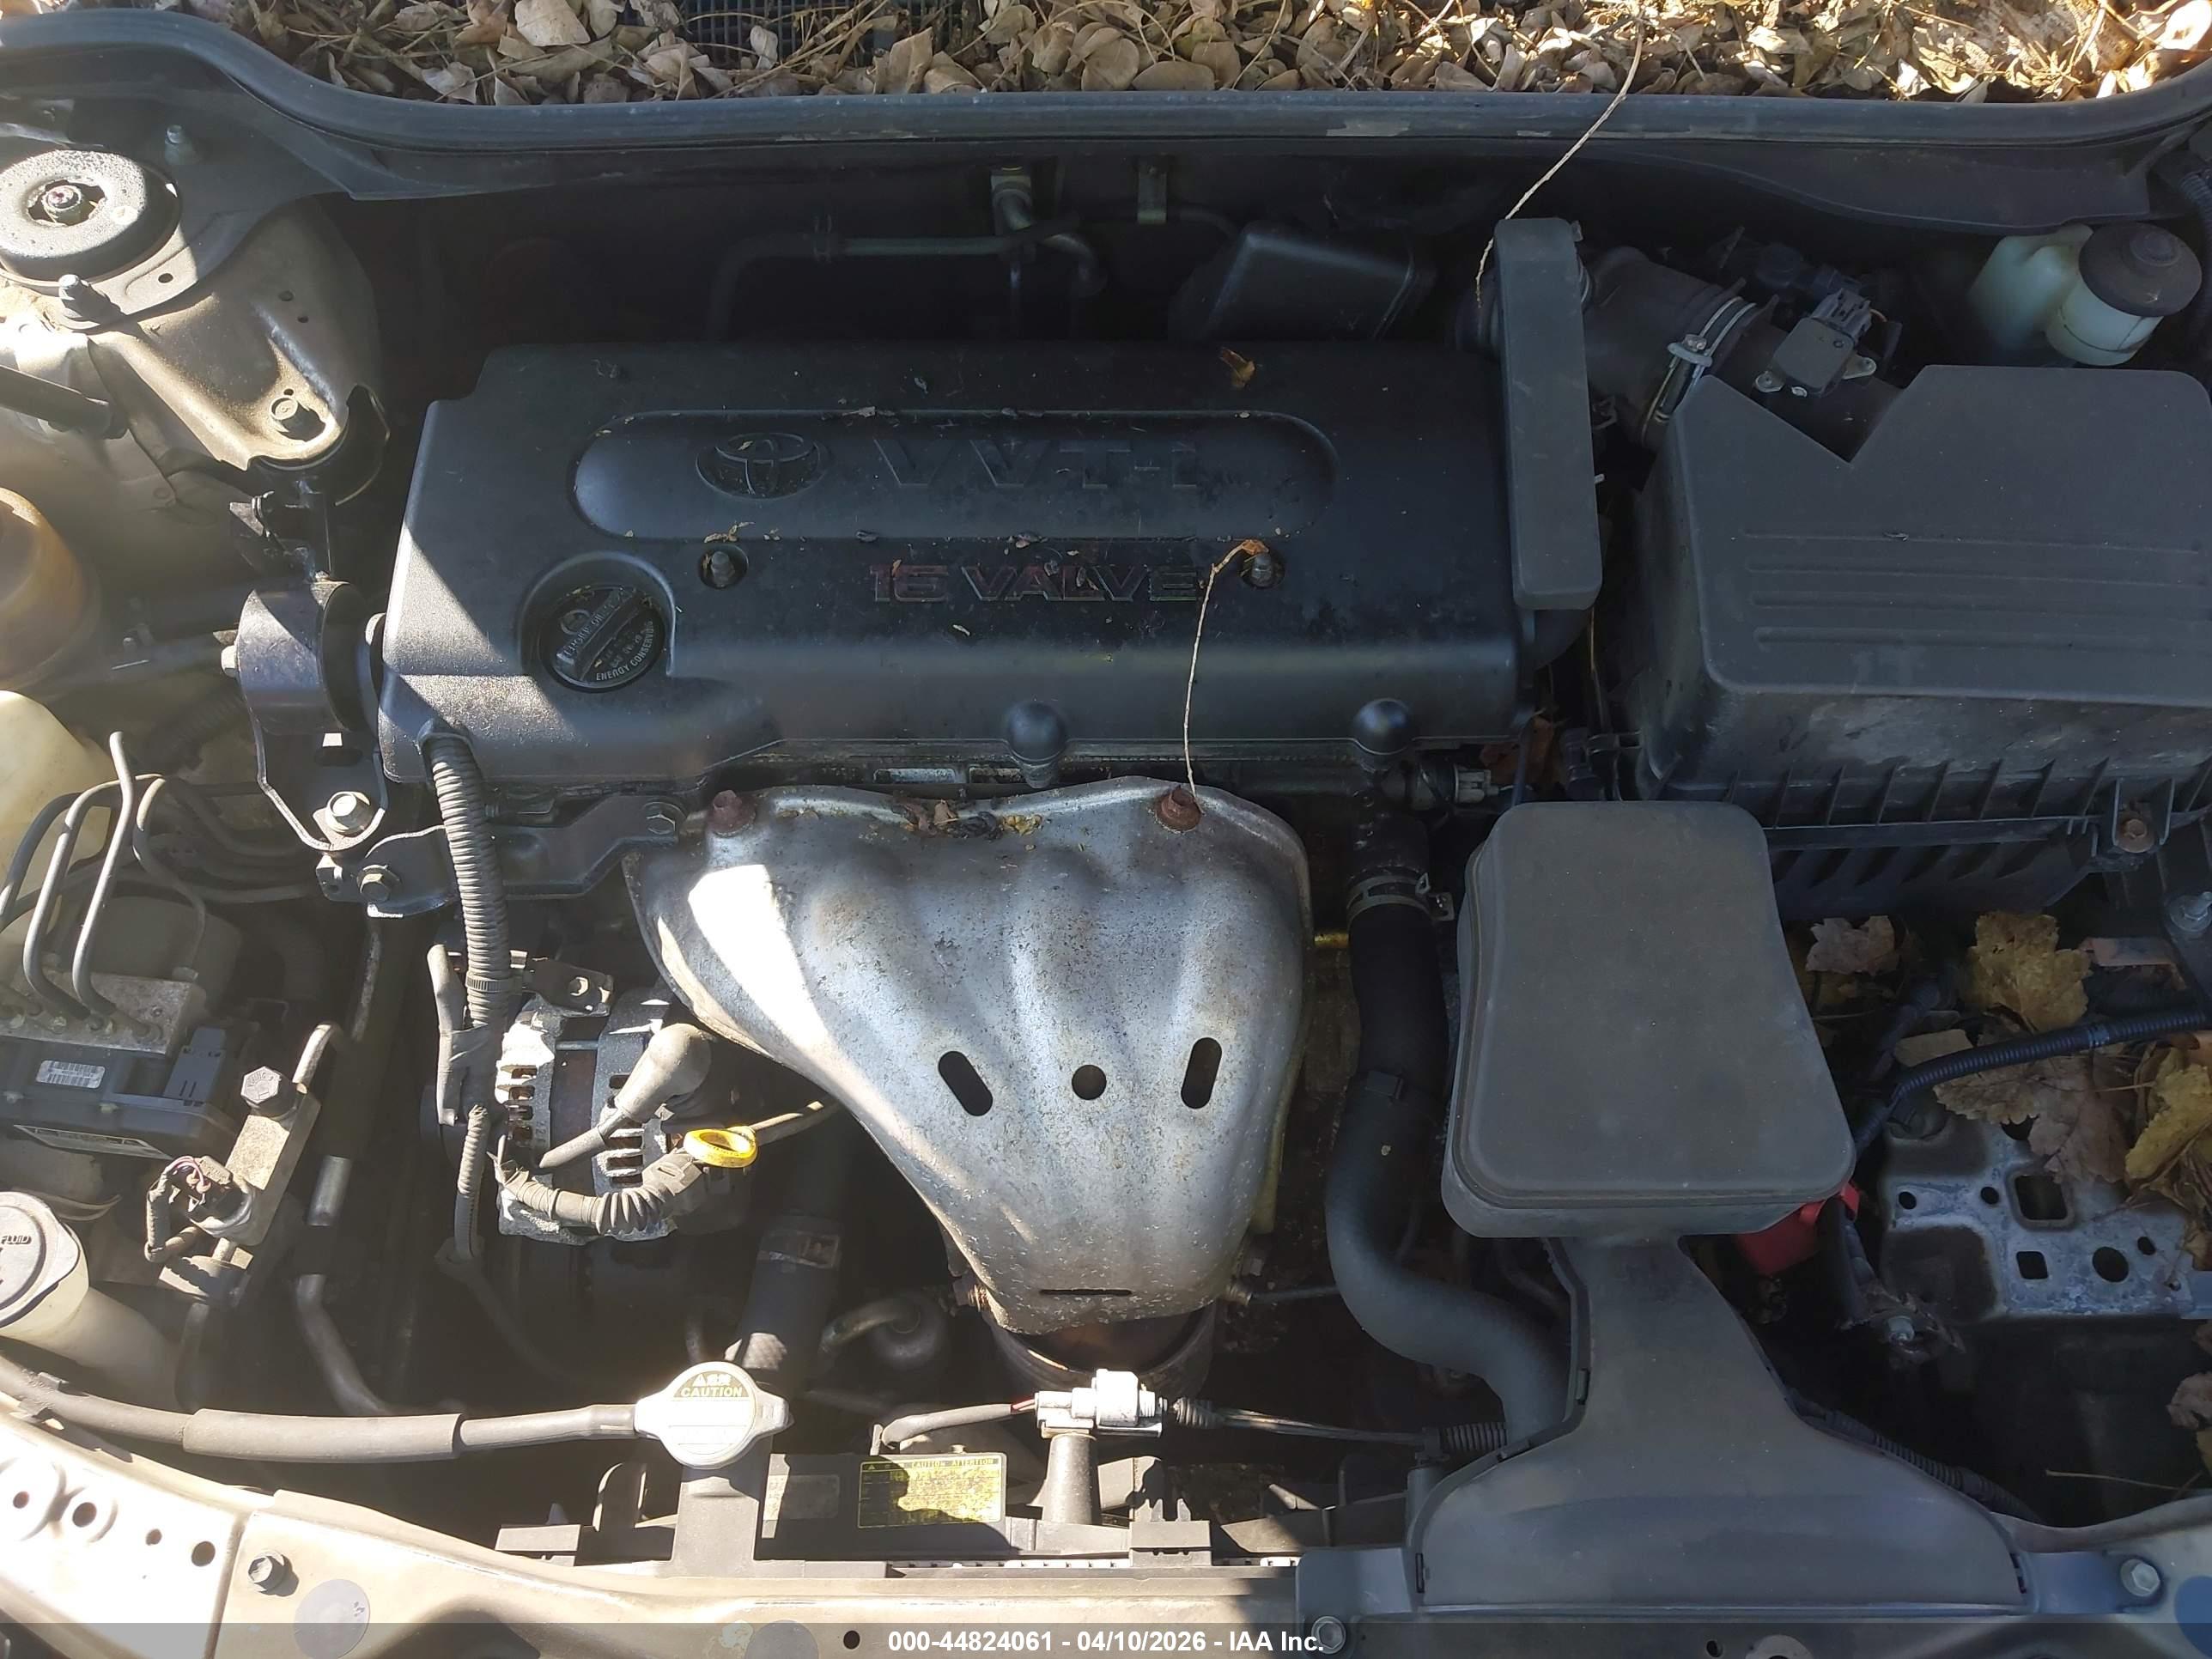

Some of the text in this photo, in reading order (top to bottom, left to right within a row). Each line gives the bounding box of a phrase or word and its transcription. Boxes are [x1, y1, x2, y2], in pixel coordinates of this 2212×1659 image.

[869, 564, 1199, 603] 16 VALVE
[596, 664, 630, 681] ENERGY
[1, 1235, 32, 1245] FLUID
[680, 1387, 744, 1397] CAUTION
